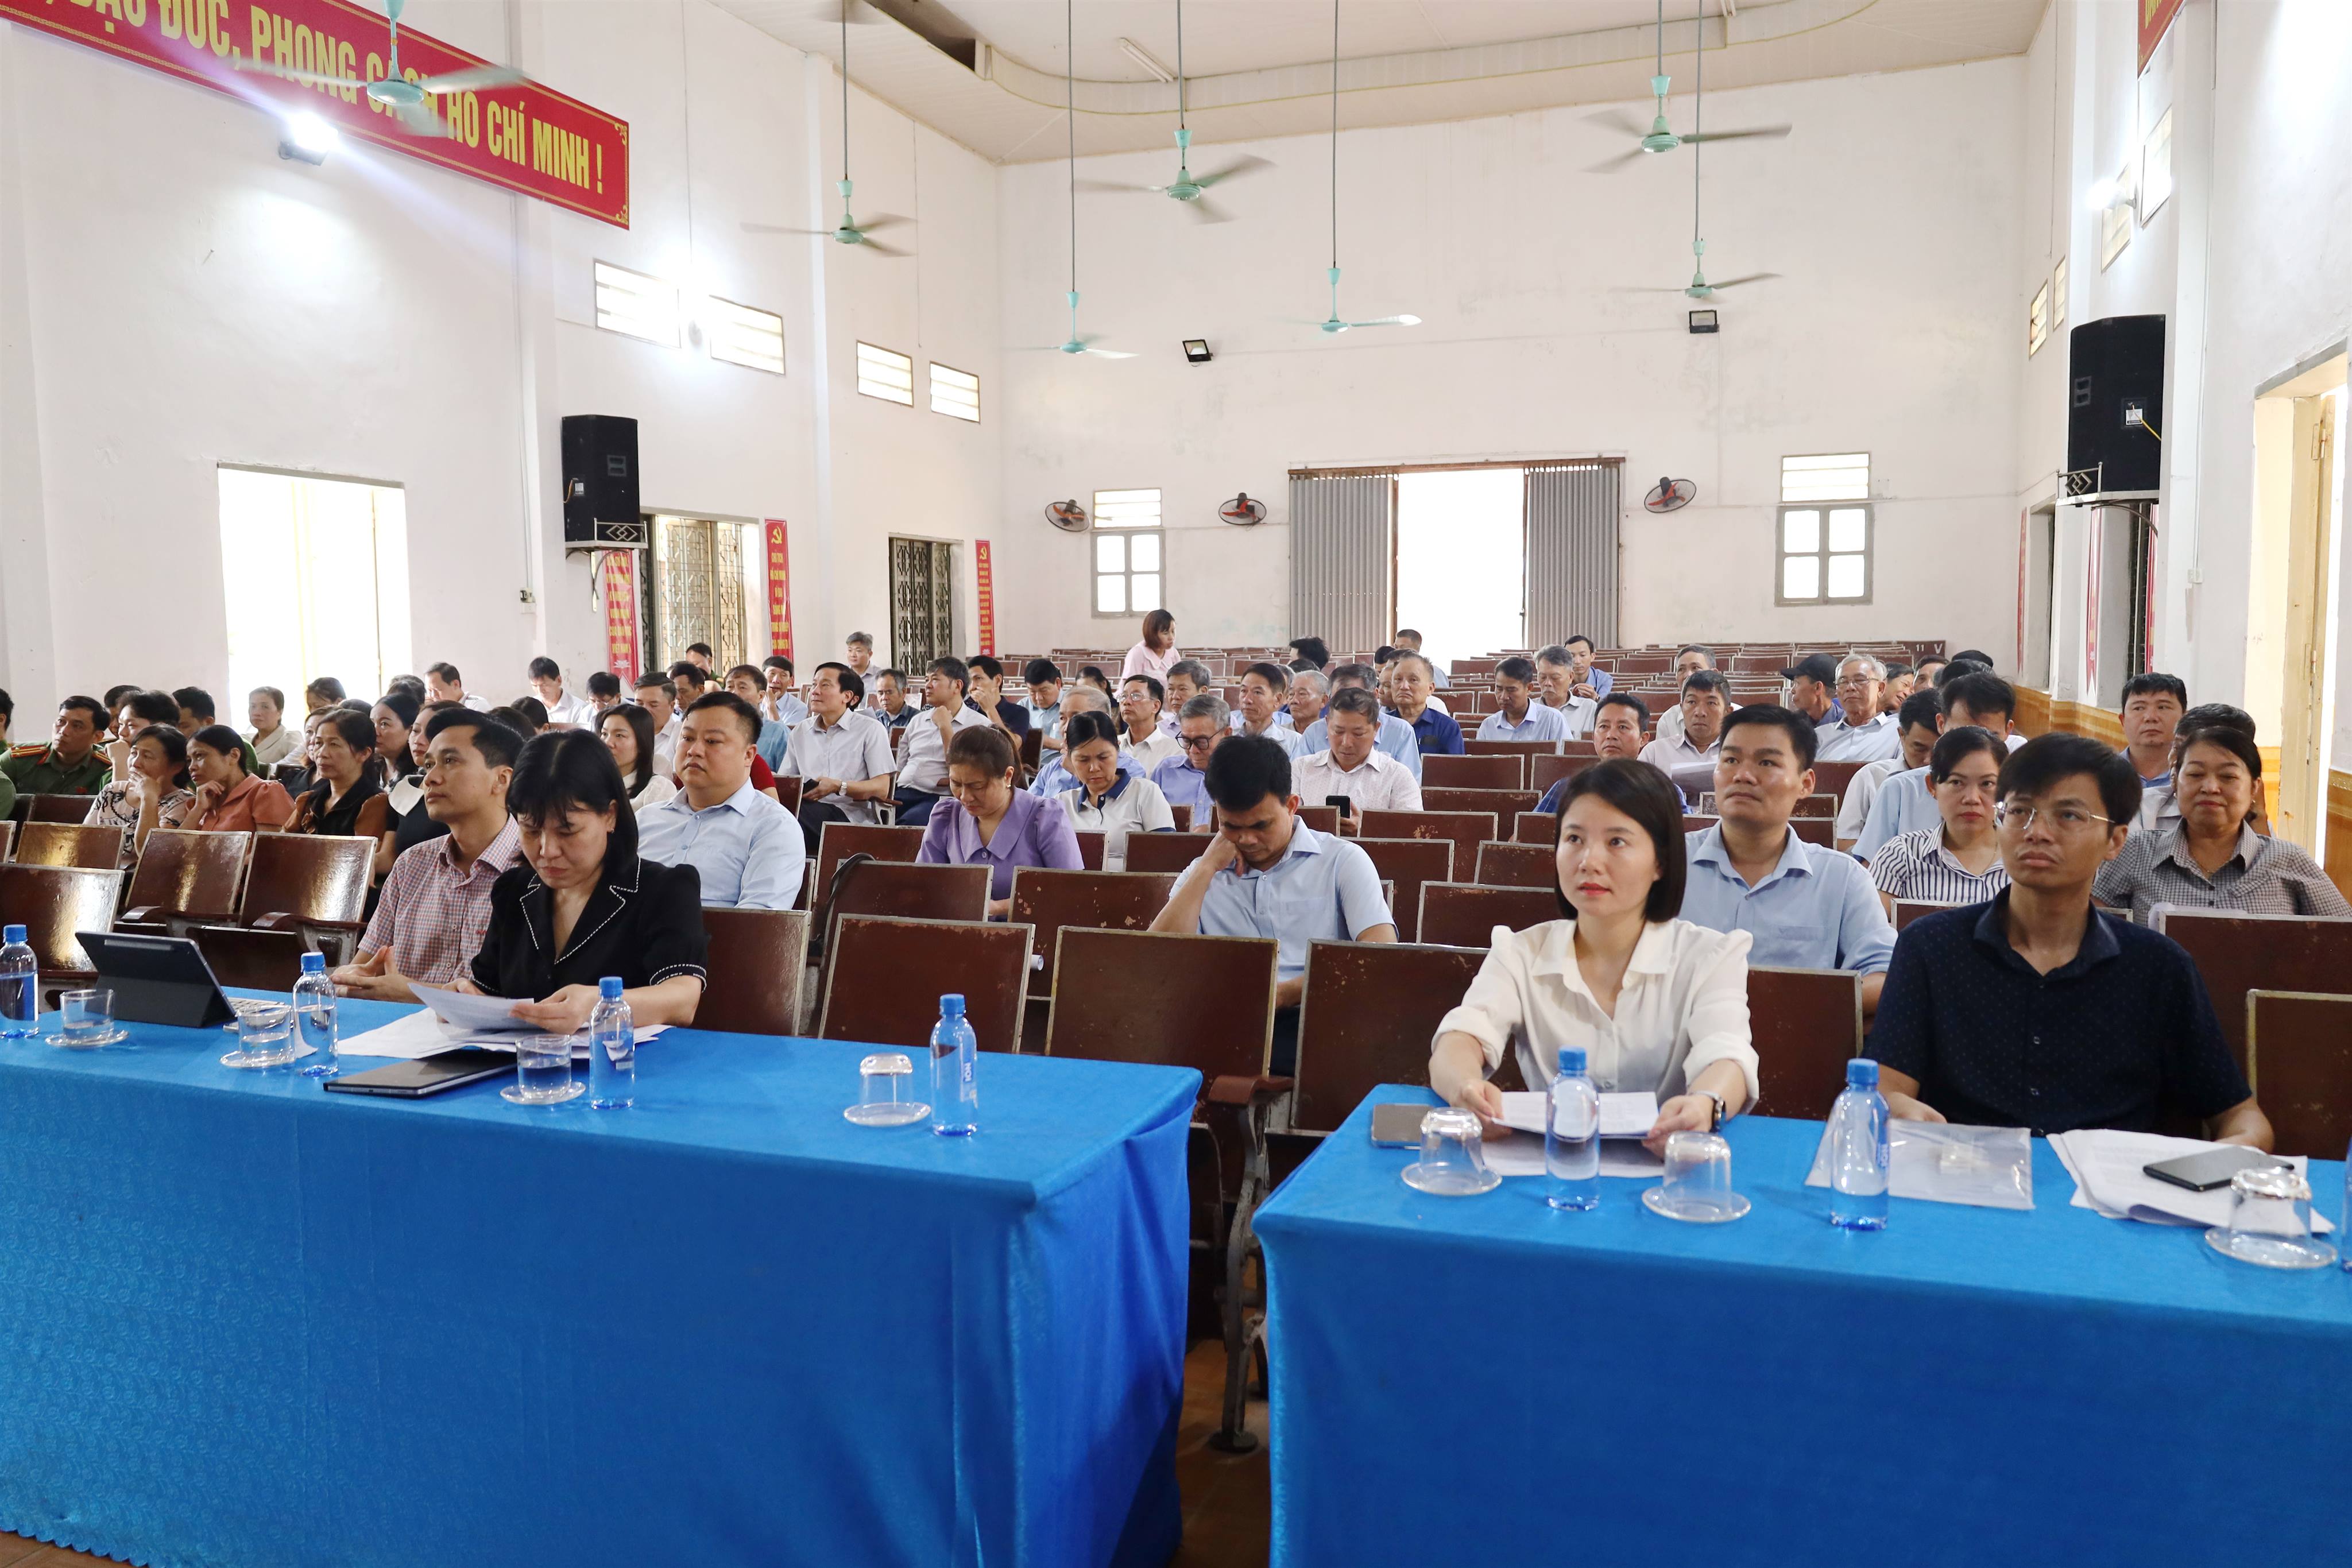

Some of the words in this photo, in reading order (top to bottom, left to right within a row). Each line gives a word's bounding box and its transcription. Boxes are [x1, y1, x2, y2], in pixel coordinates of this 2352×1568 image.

[251, 5, 358, 105] PHONG
[487, 100, 525, 166] CHÍ
[532, 117, 590, 189] MINH
[596, 144, 602, 194] !
[1916, 644, 1924, 652] 11
[1934, 643, 1943, 654] V
